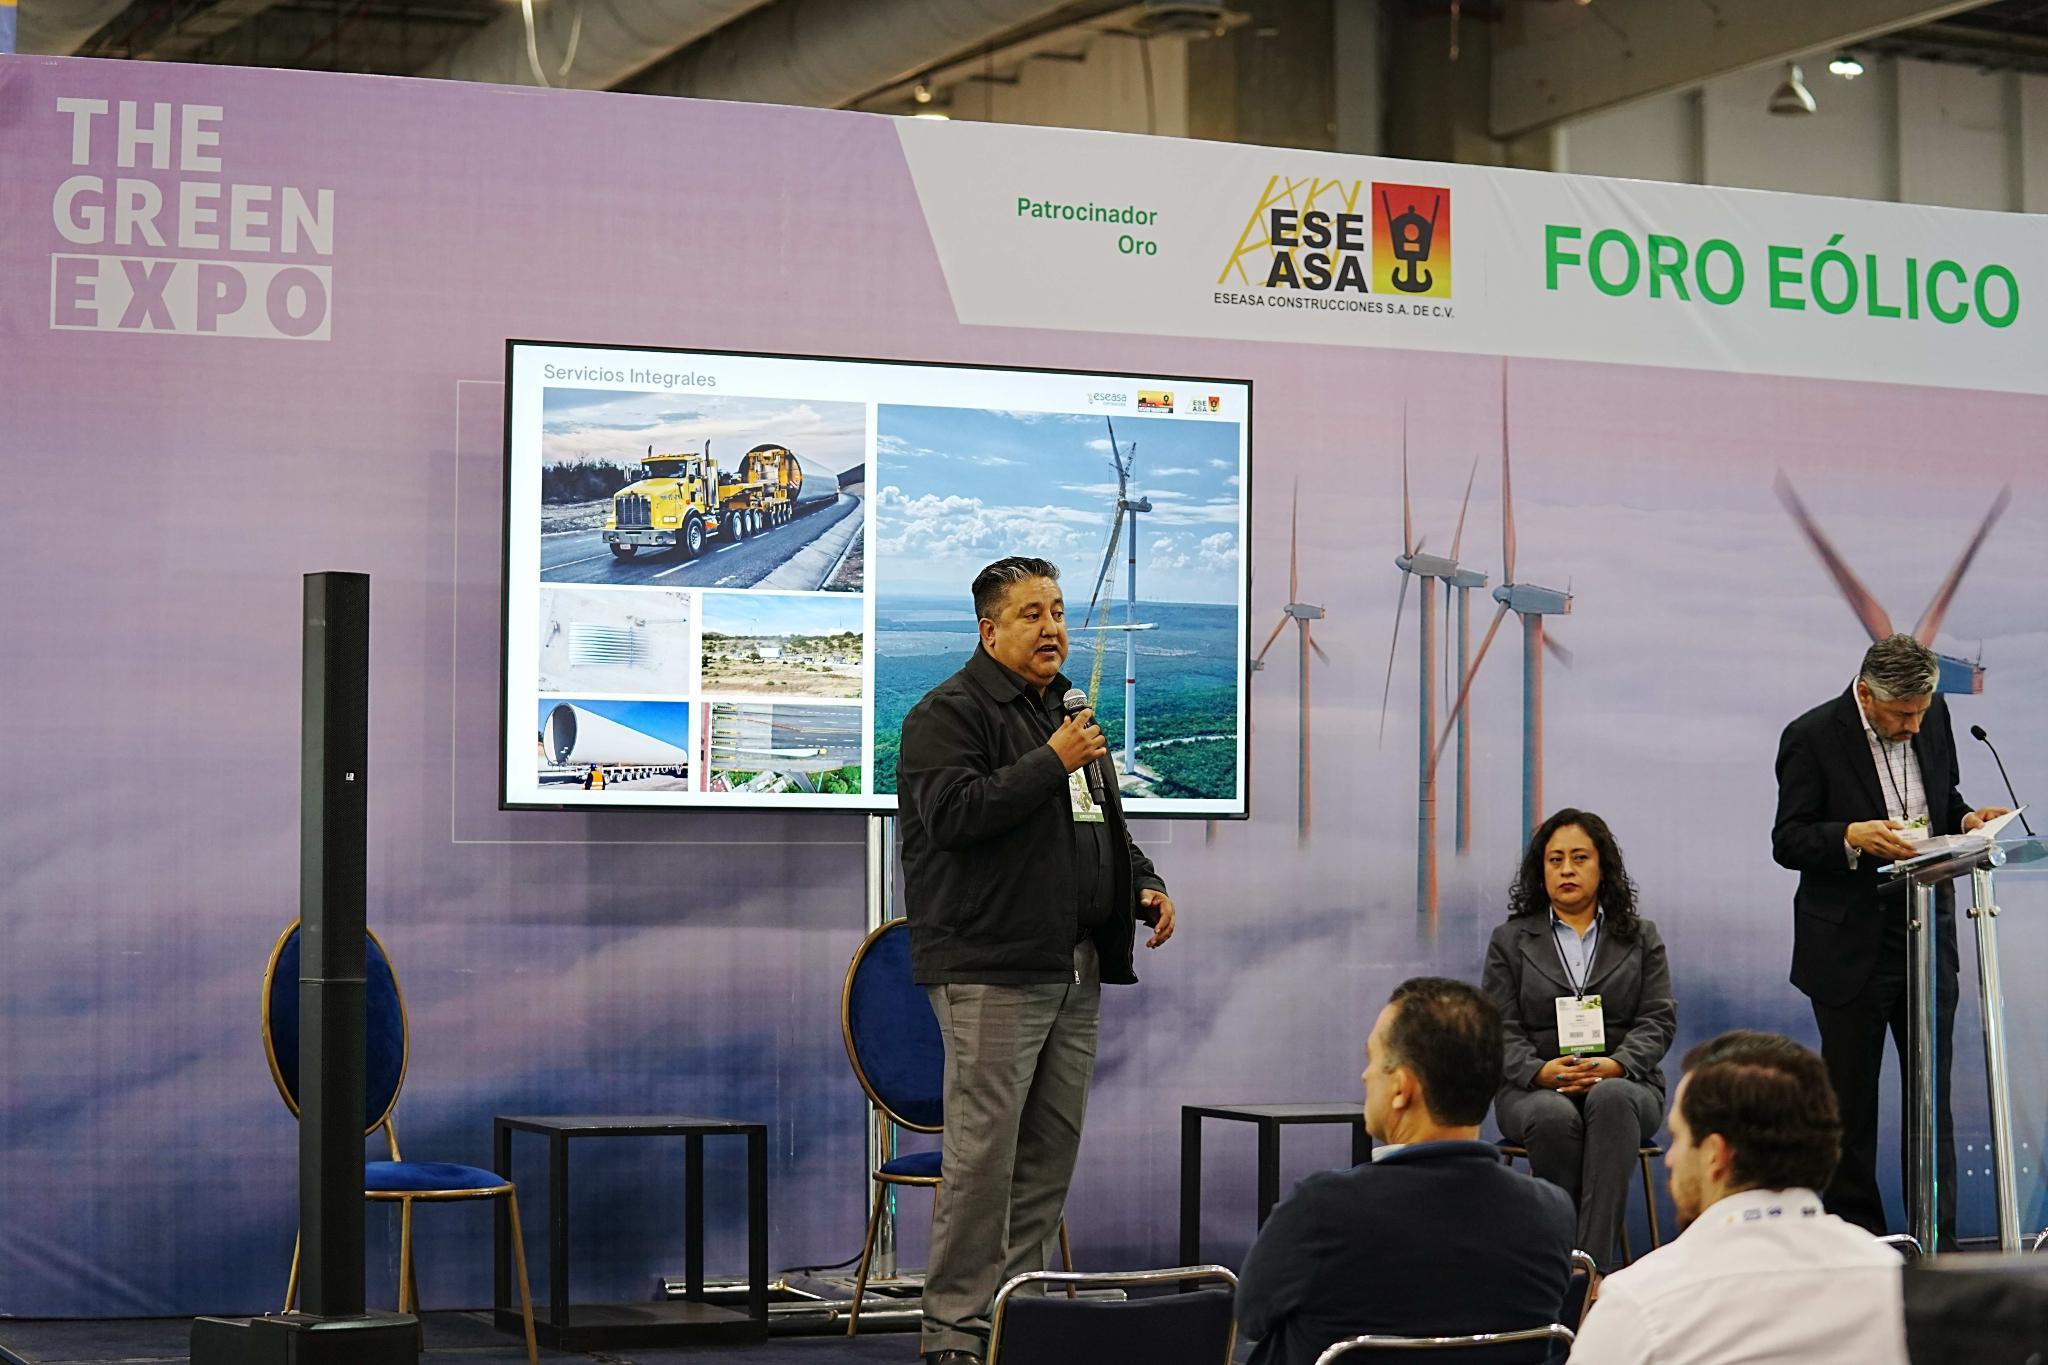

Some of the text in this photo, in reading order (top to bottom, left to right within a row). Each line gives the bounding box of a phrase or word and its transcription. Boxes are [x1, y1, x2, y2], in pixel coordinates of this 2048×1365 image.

[57, 97, 224, 172] THE
[53, 175, 335, 255] GREEN
[1017, 197, 1158, 226] Patrocinador
[1271, 208, 1364, 251] ESE
[1118, 234, 1158, 256] Oro
[1266, 251, 1369, 293] ASA
[1545, 224, 2020, 328] FORO EÓLICO
[54, 256, 328, 338] EXPO
[1214, 292, 1455, 319] ESEASA CONSTRUCCIONES S.A. DE C.V.
[544, 363, 717, 389] Servicios Integrales
